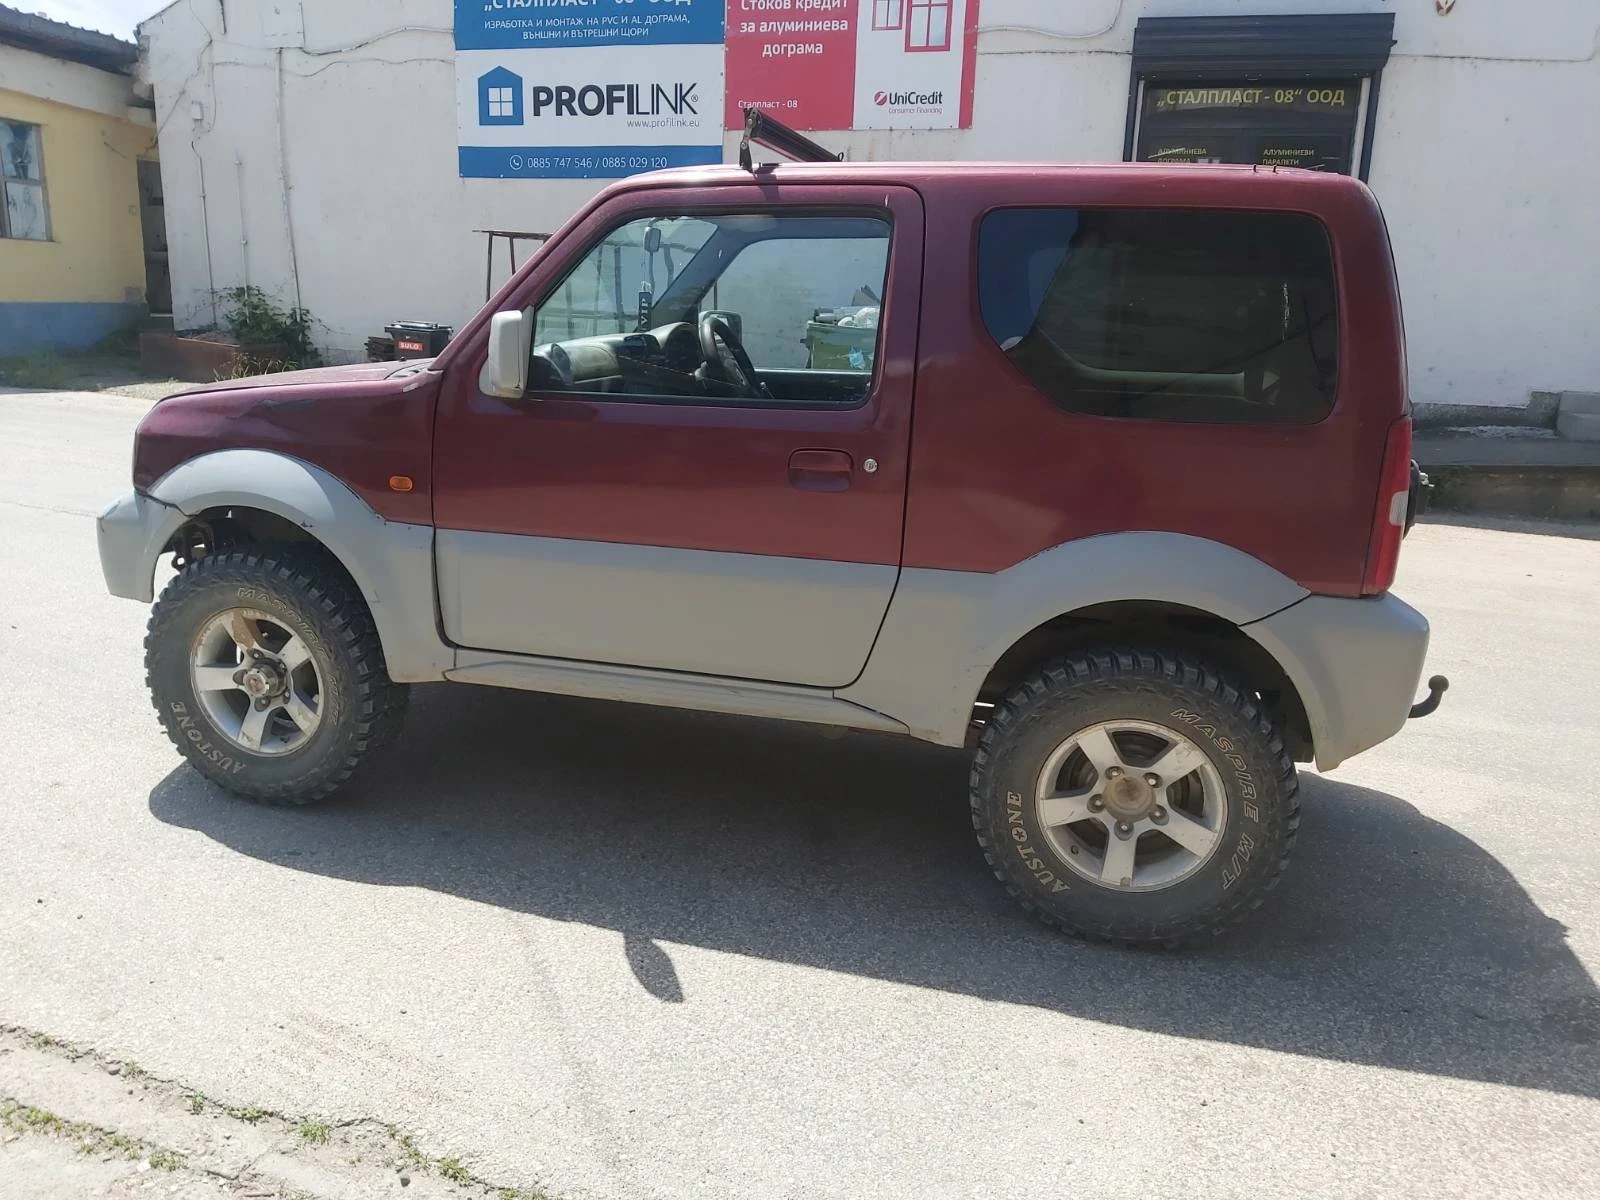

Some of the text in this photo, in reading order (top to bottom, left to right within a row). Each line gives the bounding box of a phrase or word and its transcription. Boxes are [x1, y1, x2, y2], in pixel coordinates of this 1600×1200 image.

[484, 20, 533, 29] ИЗРАБОТКА
[545, 18, 583, 27] МОНТАЖ
[587, 17, 599, 25] НА
[602, 16, 618, 24] PVC
[621, 16, 628, 24] И
[645, 14, 690, 25] ДОГРАМА,
[740, 20, 848, 35] за алуминиева
[523, 28, 649, 40] ВЪНШНИ И ВЪТРЕШНИ ЩОРИ
[762, 43, 823, 57] дограма
[738, 100, 780, 109] Сталпласт
[787, 100, 798, 108] 08
[889, 91, 943, 105] UniCredit
[1306, 89, 1345, 106] ООД
[626, 117, 700, 128] www.profilink.eu
[527, 157, 551, 169] 0885
[554, 157, 570, 169] 747
[574, 157, 592, 169] 546
[602, 156, 626, 168] 0885
[629, 156, 648, 168] 029
[651, 156, 667, 168] 120
[170, 701, 247, 774] AUSTONE
[1171, 707, 1259, 823] MASPIRE
[1007, 791, 1071, 893] AUSTONE
